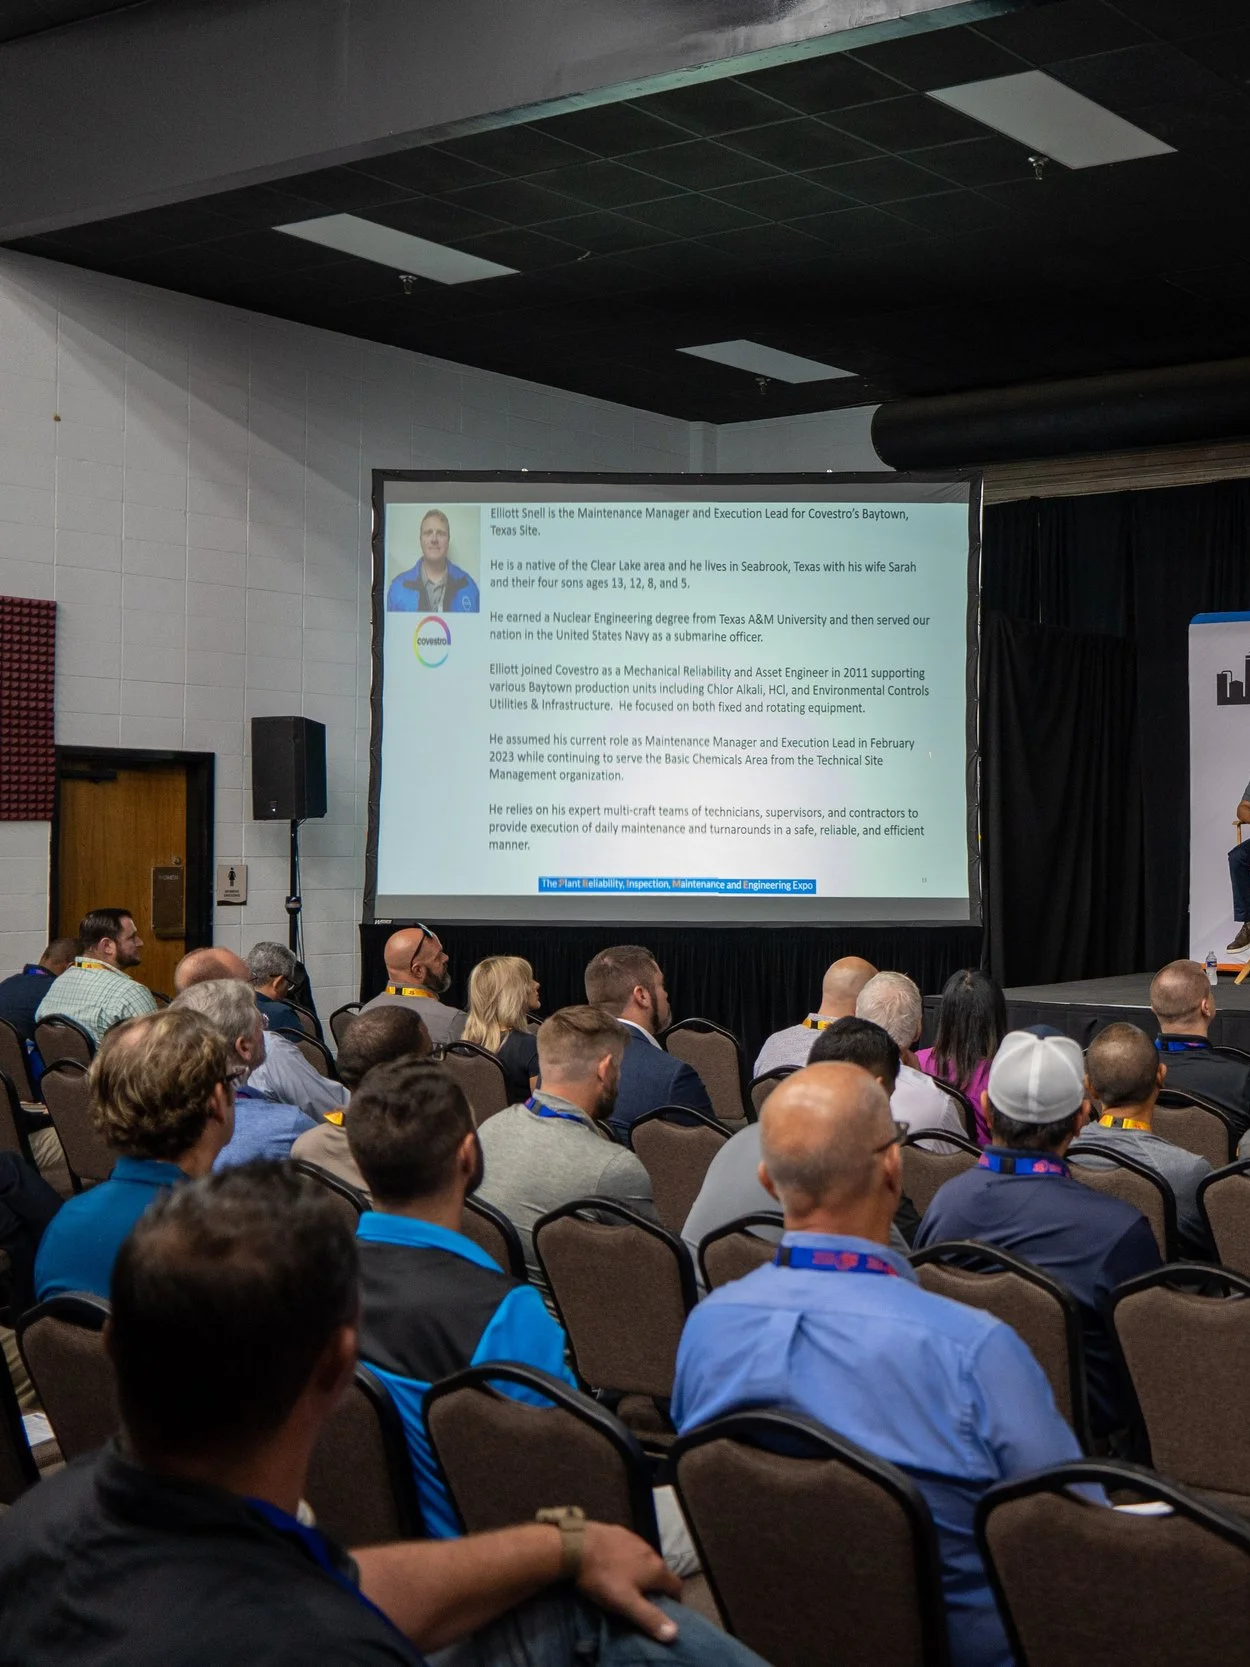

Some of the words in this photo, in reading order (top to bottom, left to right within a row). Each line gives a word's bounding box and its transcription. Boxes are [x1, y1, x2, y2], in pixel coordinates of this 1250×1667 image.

[490, 506, 519, 518] Elliott
[521, 506, 545, 518] Snell
[548, 506, 555, 518] is
[558, 506, 574, 518] the
[577, 506, 642, 518] Maintenance
[645, 506, 689, 521] Manager
[692, 506, 710, 518] and
[714, 506, 762, 518] Execution
[765, 506, 788, 519] Lead
[790, 507, 805, 519] for
[808, 507, 859, 519] Covestro's
[862, 507, 908, 522] Baytown,
[490, 523, 516, 535] Texas
[519, 523, 540, 536] Site.
[490, 558, 503, 570] He
[506, 558, 514, 570] is
[516, 561, 522, 570] a
[525, 558, 555, 570] native
[558, 558, 569, 570] of
[571, 558, 587, 570] the
[590, 558, 616, 570] Clear
[619, 559, 641, 571] Lake
[643, 562, 665, 571] area
[668, 559, 686, 571] and
[689, 559, 702, 571] he
[704, 559, 728, 571] lives
[729, 559, 738, 571] in
[740, 559, 790, 573] Seabrook,
[793, 559, 820, 571] Texas
[822, 560, 845, 572] with
[848, 560, 862, 572] his
[864, 560, 886, 572] wife
[888, 560, 916, 572] Sarah
[490, 574, 508, 588] and
[511, 574, 535, 588] their
[537, 575, 558, 588] four
[561, 578, 583, 588] sons
[586, 578, 608, 591] ages
[612, 575, 626, 590] 13,
[630, 575, 644, 590] 12,
[647, 575, 656, 590] 8,
[659, 576, 678, 589] and
[681, 576, 690, 589] 5.
[490, 610, 503, 622] He
[506, 610, 541, 623] earned
[544, 613, 549, 623] a
[552, 611, 591, 623] Nuclear
[594, 611, 652, 626] Engineering
[654, 611, 689, 626] degree
[692, 612, 716, 624] from
[718, 612, 745, 624] Texas
[748, 612, 773, 624] A&M
[777, 612, 827, 627] University
[829, 612, 848, 625] and
[850, 613, 874, 625] then
[876, 613, 909, 625] served
[912, 616, 930, 625] our
[416, 637, 447, 646] covestro
[489, 627, 521, 640] nation
[524, 628, 533, 640] in
[536, 628, 553, 640] the
[556, 628, 589, 640] United
[592, 628, 622, 641] States
[624, 628, 649, 643] Navy
[652, 632, 662, 641] as
[665, 632, 671, 641] a
[674, 629, 726, 642] submarine
[729, 629, 763, 642] officer.
[489, 662, 518, 675] Elliott
[520, 662, 552, 678] joined
[555, 663, 599, 676] Covestro
[601, 666, 612, 676] as
[615, 666, 620, 676] a
[623, 663, 680, 676] Mechanical
[683, 664, 731, 679] Reliability
[734, 664, 752, 677] and
[754, 664, 782, 677] Asset
[785, 665, 828, 680] Engineer
[831, 665, 840, 678] in
[843, 665, 868, 678] 2011
[870, 665, 925, 681] supporting
[489, 680, 525, 692] various
[528, 680, 572, 695] Baytown
[574, 680, 629, 696] production
[632, 681, 656, 693] units
[659, 681, 704, 696] including
[706, 682, 733, 694] Chlor
[735, 682, 765, 696] Alkali,
[768, 682, 789, 696] HCl,
[791, 682, 809, 695] and
[812, 682, 884, 695] Environmental
[887, 683, 929, 696] Controls
[489, 697, 527, 709] Utilities
[530, 698, 538, 710] &
[542, 698, 612, 710] Infrastructure.
[619, 699, 632, 711] He
[635, 699, 673, 711] focused
[676, 702, 689, 711] on
[692, 699, 715, 712] both
[718, 700, 742, 712] fixed
[744, 700, 763, 712] and
[766, 700, 805, 715] rotating
[808, 701, 865, 716] equipment.
[489, 733, 503, 745] He
[506, 733, 550, 745] assumed
[553, 733, 567, 745] his
[569, 735, 606, 746] current
[609, 734, 628, 746] role
[631, 737, 642, 746] as
[645, 734, 709, 746] Maintenance
[712, 734, 757, 749] Manager
[759, 735, 778, 747] and
[781, 735, 829, 747] Execution
[832, 735, 855, 748] Lead
[858, 736, 867, 748] in
[870, 736, 914, 751] February
[489, 803, 502, 814] He
[506, 803, 532, 815] relies
[535, 806, 548, 815] on
[551, 803, 565, 815] his
[568, 805, 600, 818] expert
[603, 804, 655, 816] multi-craft
[658, 806, 688, 816] teams
[691, 805, 701, 816] of
[704, 805, 762, 818] technicians,
[765, 805, 824, 820] supervisors,
[827, 806, 846, 818] and
[848, 807, 905, 818] contractors
[907, 808, 918, 818] to
[542, 880, 558, 888] The
[558, 880, 581, 888] Plant
[626, 880, 671, 890] Inspection,
[672, 880, 725, 889] Maintenance
[726, 880, 742, 889] and
[743, 880, 791, 891] Engineering
[792, 881, 813, 891] Expo
